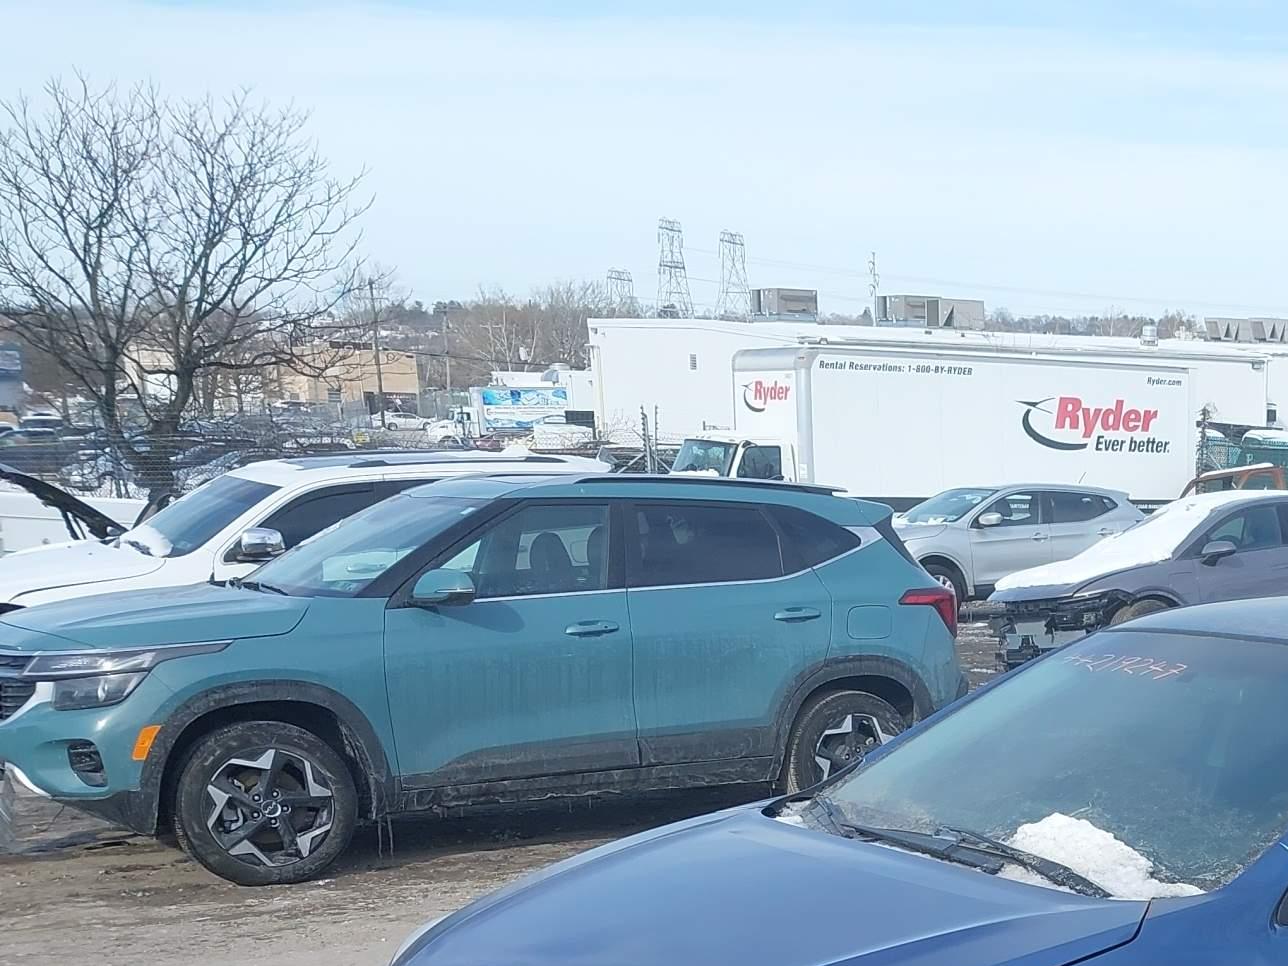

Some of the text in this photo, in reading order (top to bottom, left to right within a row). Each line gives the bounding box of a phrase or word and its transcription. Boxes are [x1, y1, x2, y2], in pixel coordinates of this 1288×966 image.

[819, 360, 973, 376] Rental Reservations: 1-800-BY-RYDER
[1147, 376, 1182, 387] Ryder.com
[754, 380, 791, 405] Ryder
[1055, 396, 1159, 438] Ryder
[1095, 435, 1171, 453] Ever better.
